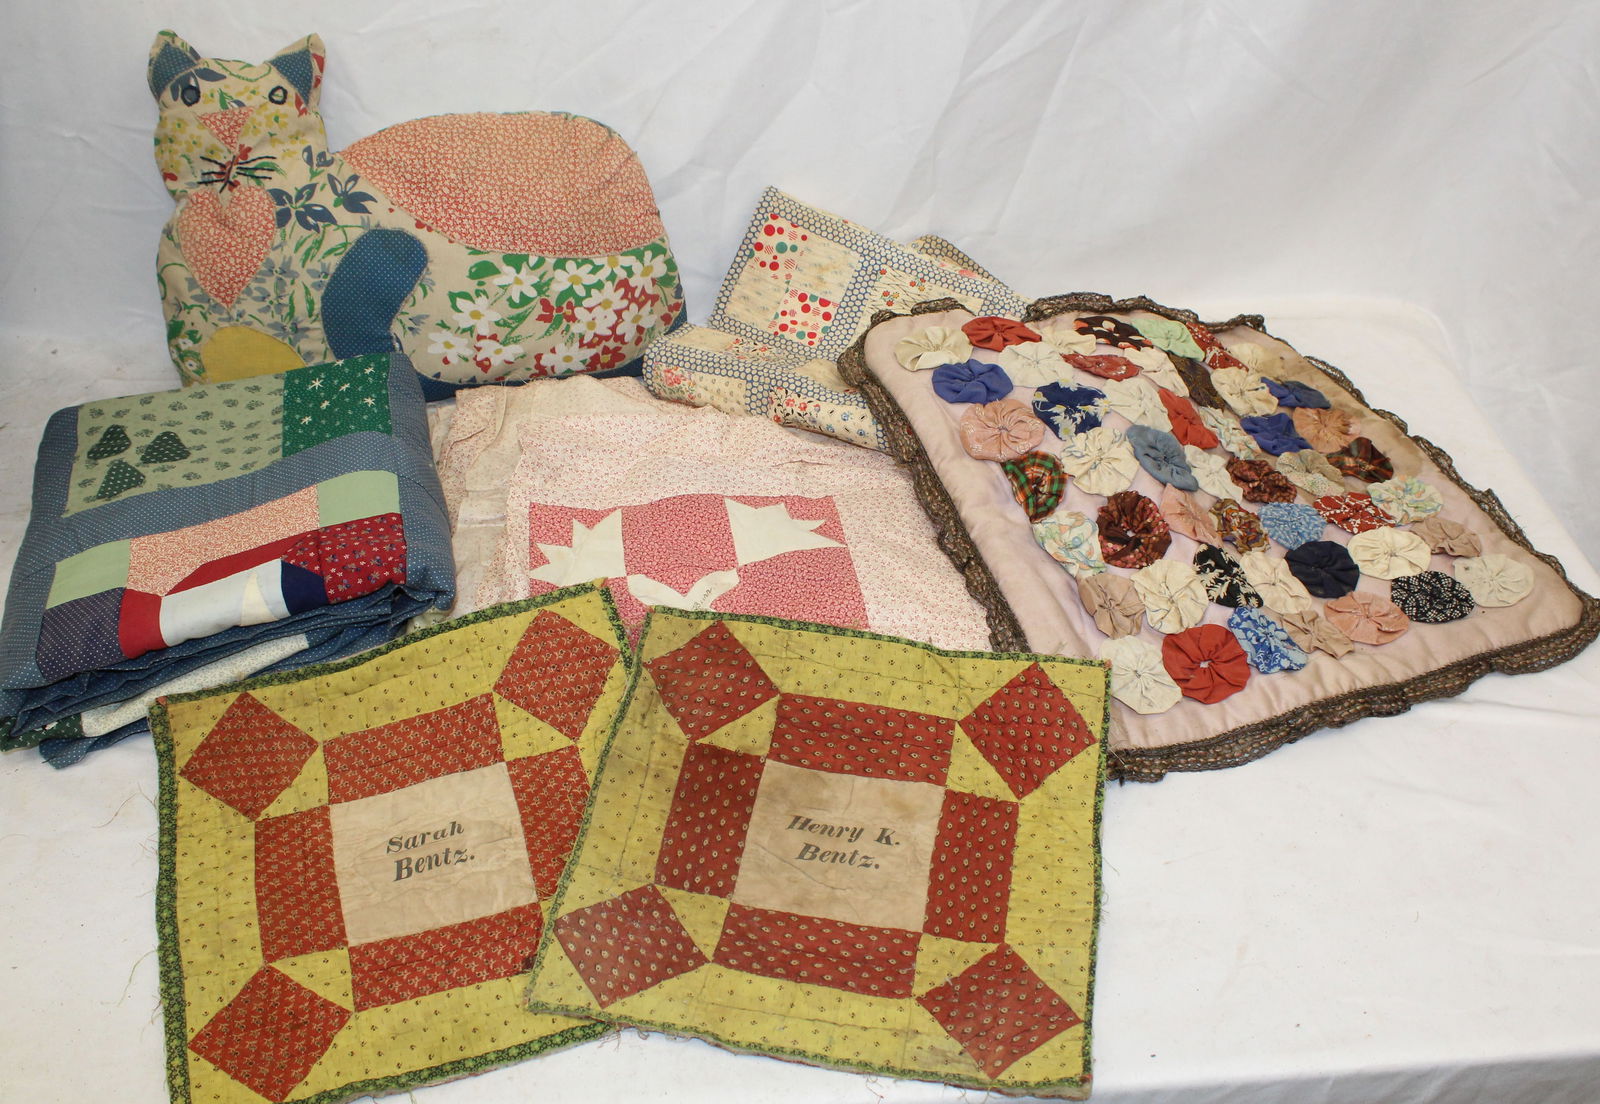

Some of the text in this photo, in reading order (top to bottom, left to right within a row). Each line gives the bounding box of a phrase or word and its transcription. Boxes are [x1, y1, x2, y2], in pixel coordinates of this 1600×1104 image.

[386, 821, 465, 854] Sarah
[784, 814, 900, 845] Henry K.
[392, 847, 475, 882] Bentz.
[793, 842, 880, 869] Bentz.
